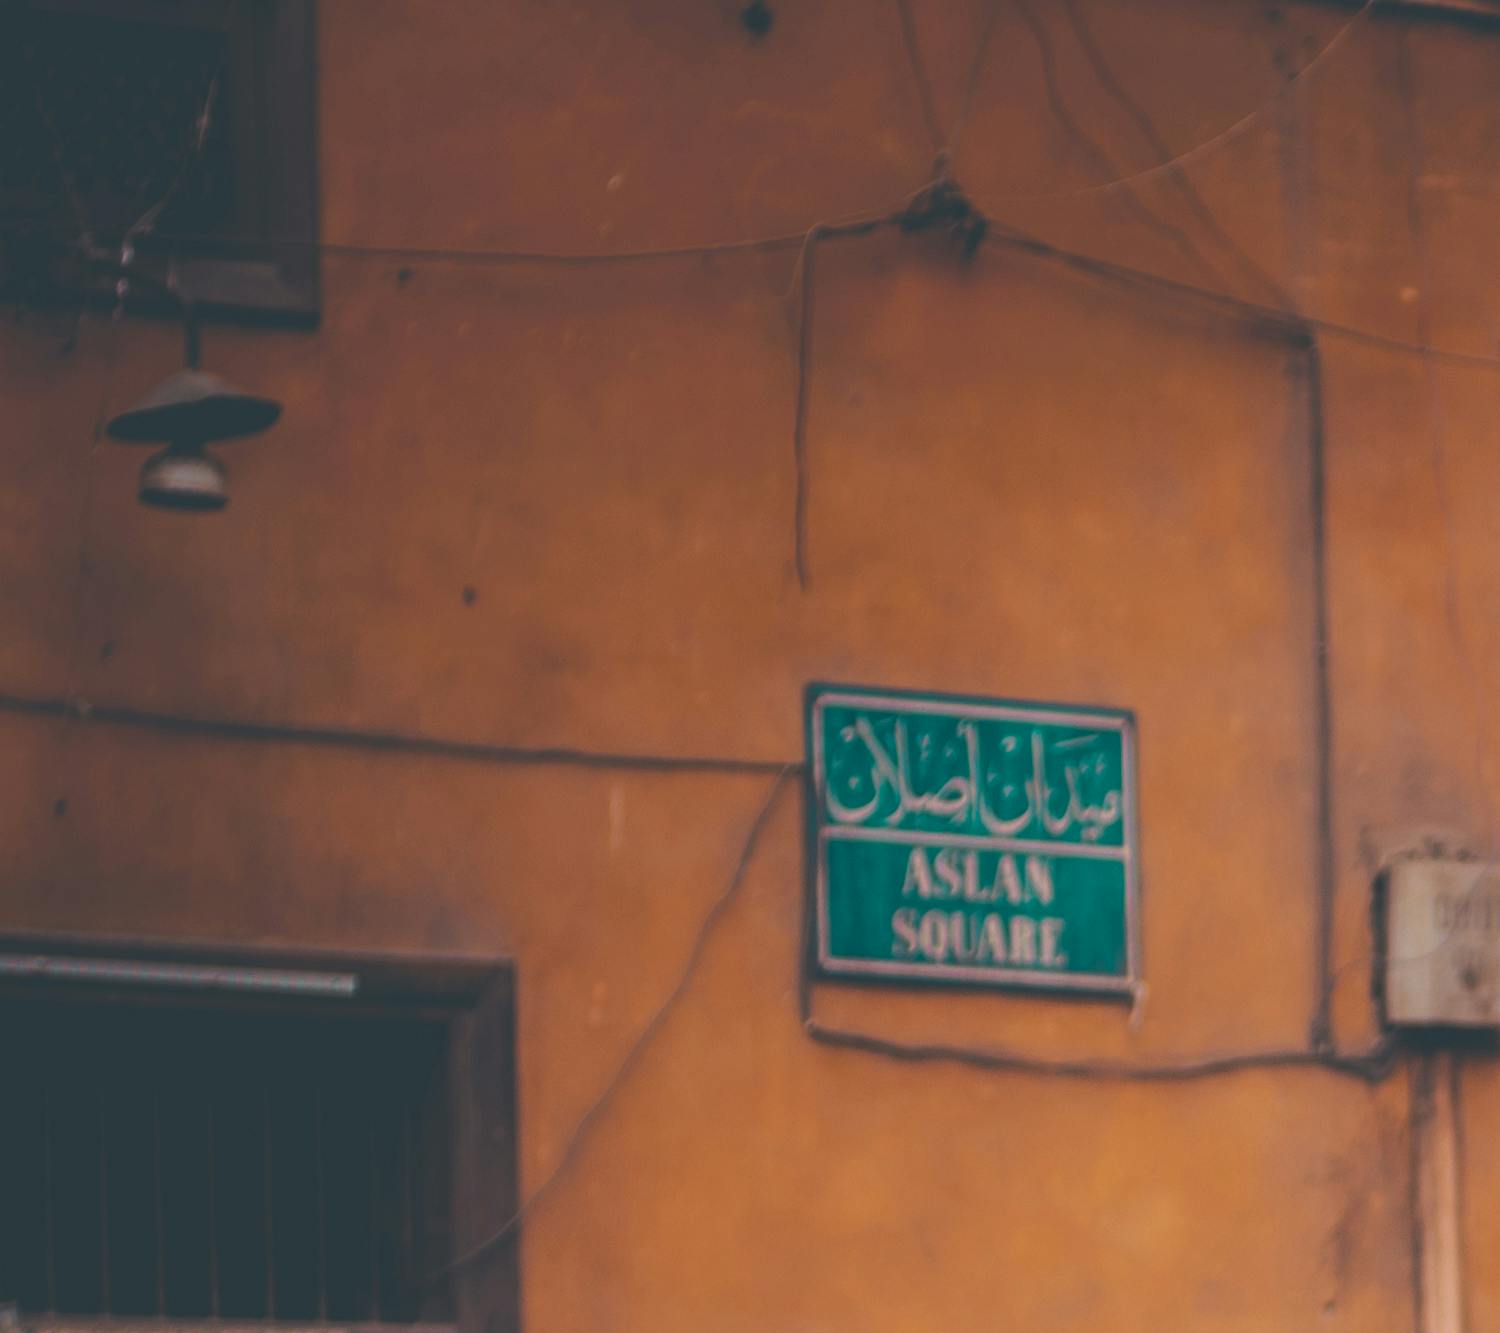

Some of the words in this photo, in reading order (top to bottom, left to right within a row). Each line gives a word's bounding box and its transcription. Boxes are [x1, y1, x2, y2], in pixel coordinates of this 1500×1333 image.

[977, 731, 1121, 840] ميدان
[902, 846, 1055, 905] ASLAN
[891, 909, 1068, 966] SQUARE
